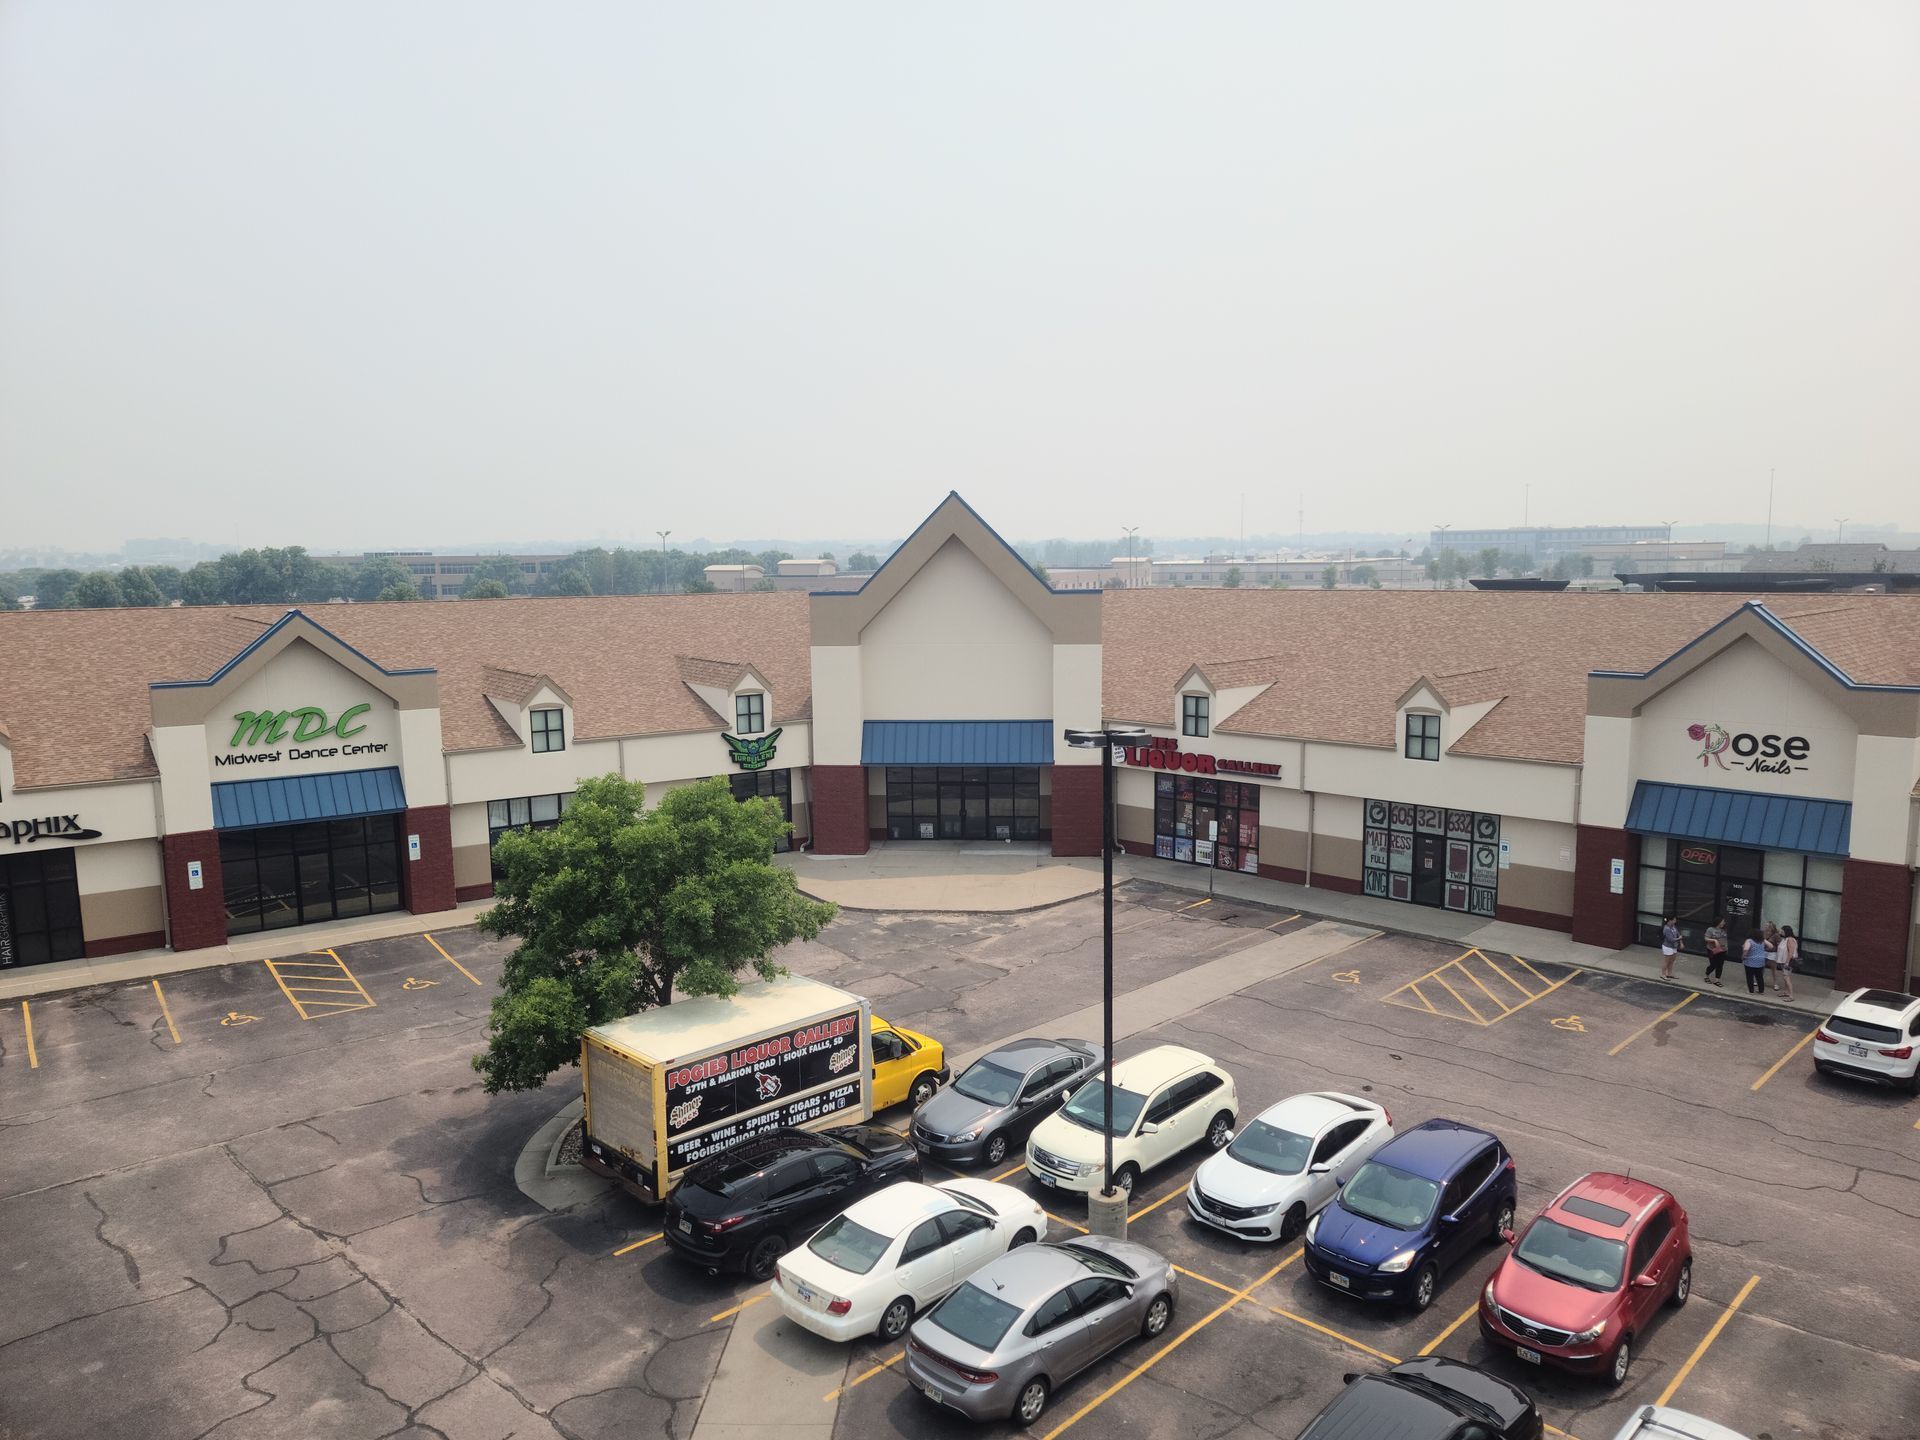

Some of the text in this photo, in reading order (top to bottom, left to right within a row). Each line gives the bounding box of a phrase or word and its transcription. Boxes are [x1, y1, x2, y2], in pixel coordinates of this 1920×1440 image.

[230, 703, 371, 747] MDC
[215, 743, 388, 766] Midwest Dance Center
[1151, 736, 1178, 751] IES
[1126, 746, 1218, 775] LIQUOR
[1217, 758, 1282, 775] GALLERY
[1745, 758, 1792, 775] Nails
[1391, 805, 1415, 827] 605
[1418, 809, 1443, 830] 321
[1366, 831, 1411, 850] MATTRESS
[1370, 854, 1386, 865] FULL
[1681, 848, 1717, 864] OPEN
[1365, 869, 1387, 894] KING
[1449, 871, 1466, 881] TWIN
[668, 1015, 856, 1090] FOGIES LIQUOR GALLERY
[829, 1044, 857, 1070] Shiner
[834, 1056, 854, 1073] BOCK
[685, 1036, 844, 1095] 57TH & MARION ROAD SIOUX FALLS, SD
[670, 1095, 703, 1125] Shiner
[676, 1109, 699, 1129] BOCK
[677, 1085, 854, 1155] BEER WINE SPIRITS CIGARS PIZZA
[788, 1112, 807, 1126] LIKE
[809, 1107, 820, 1118] US
[822, 1101, 836, 1113] ON
